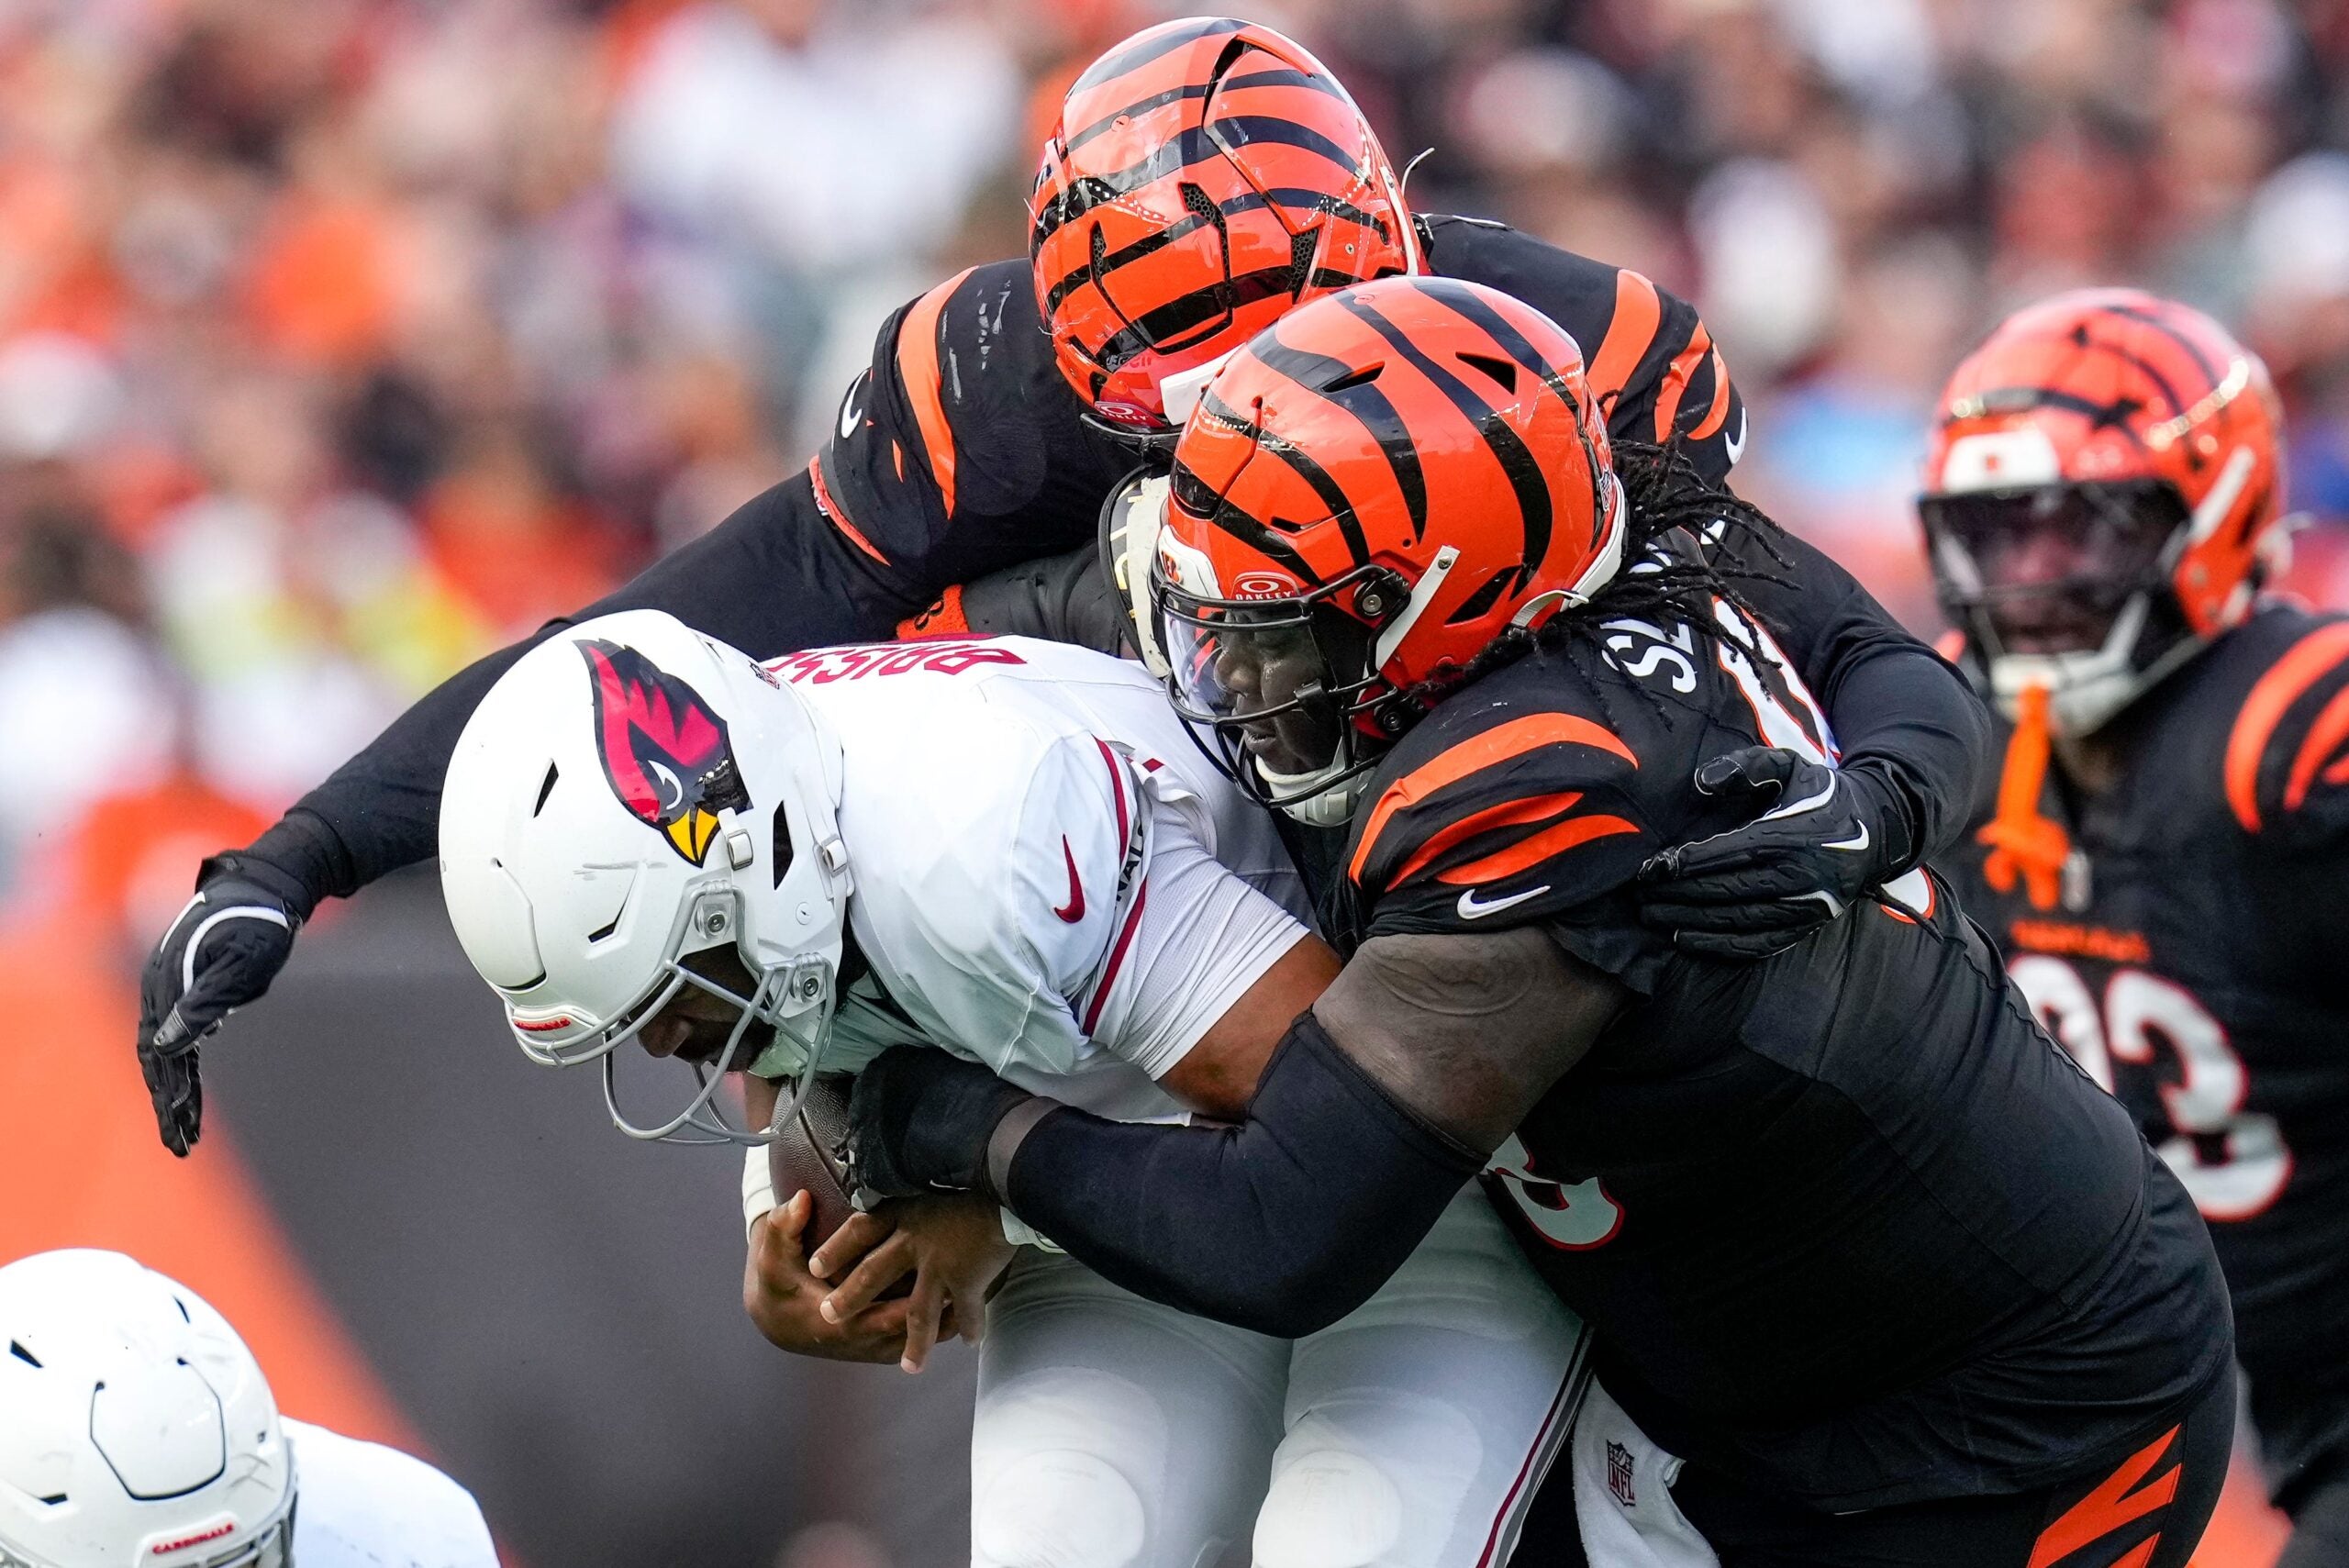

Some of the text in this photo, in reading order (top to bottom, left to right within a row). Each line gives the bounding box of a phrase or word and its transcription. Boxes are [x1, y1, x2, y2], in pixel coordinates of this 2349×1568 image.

[1099, 409, 1148, 421] OAKLEY
[1235, 590, 1292, 601] OAKLEY
[1610, 1462, 1635, 1500] NFL
